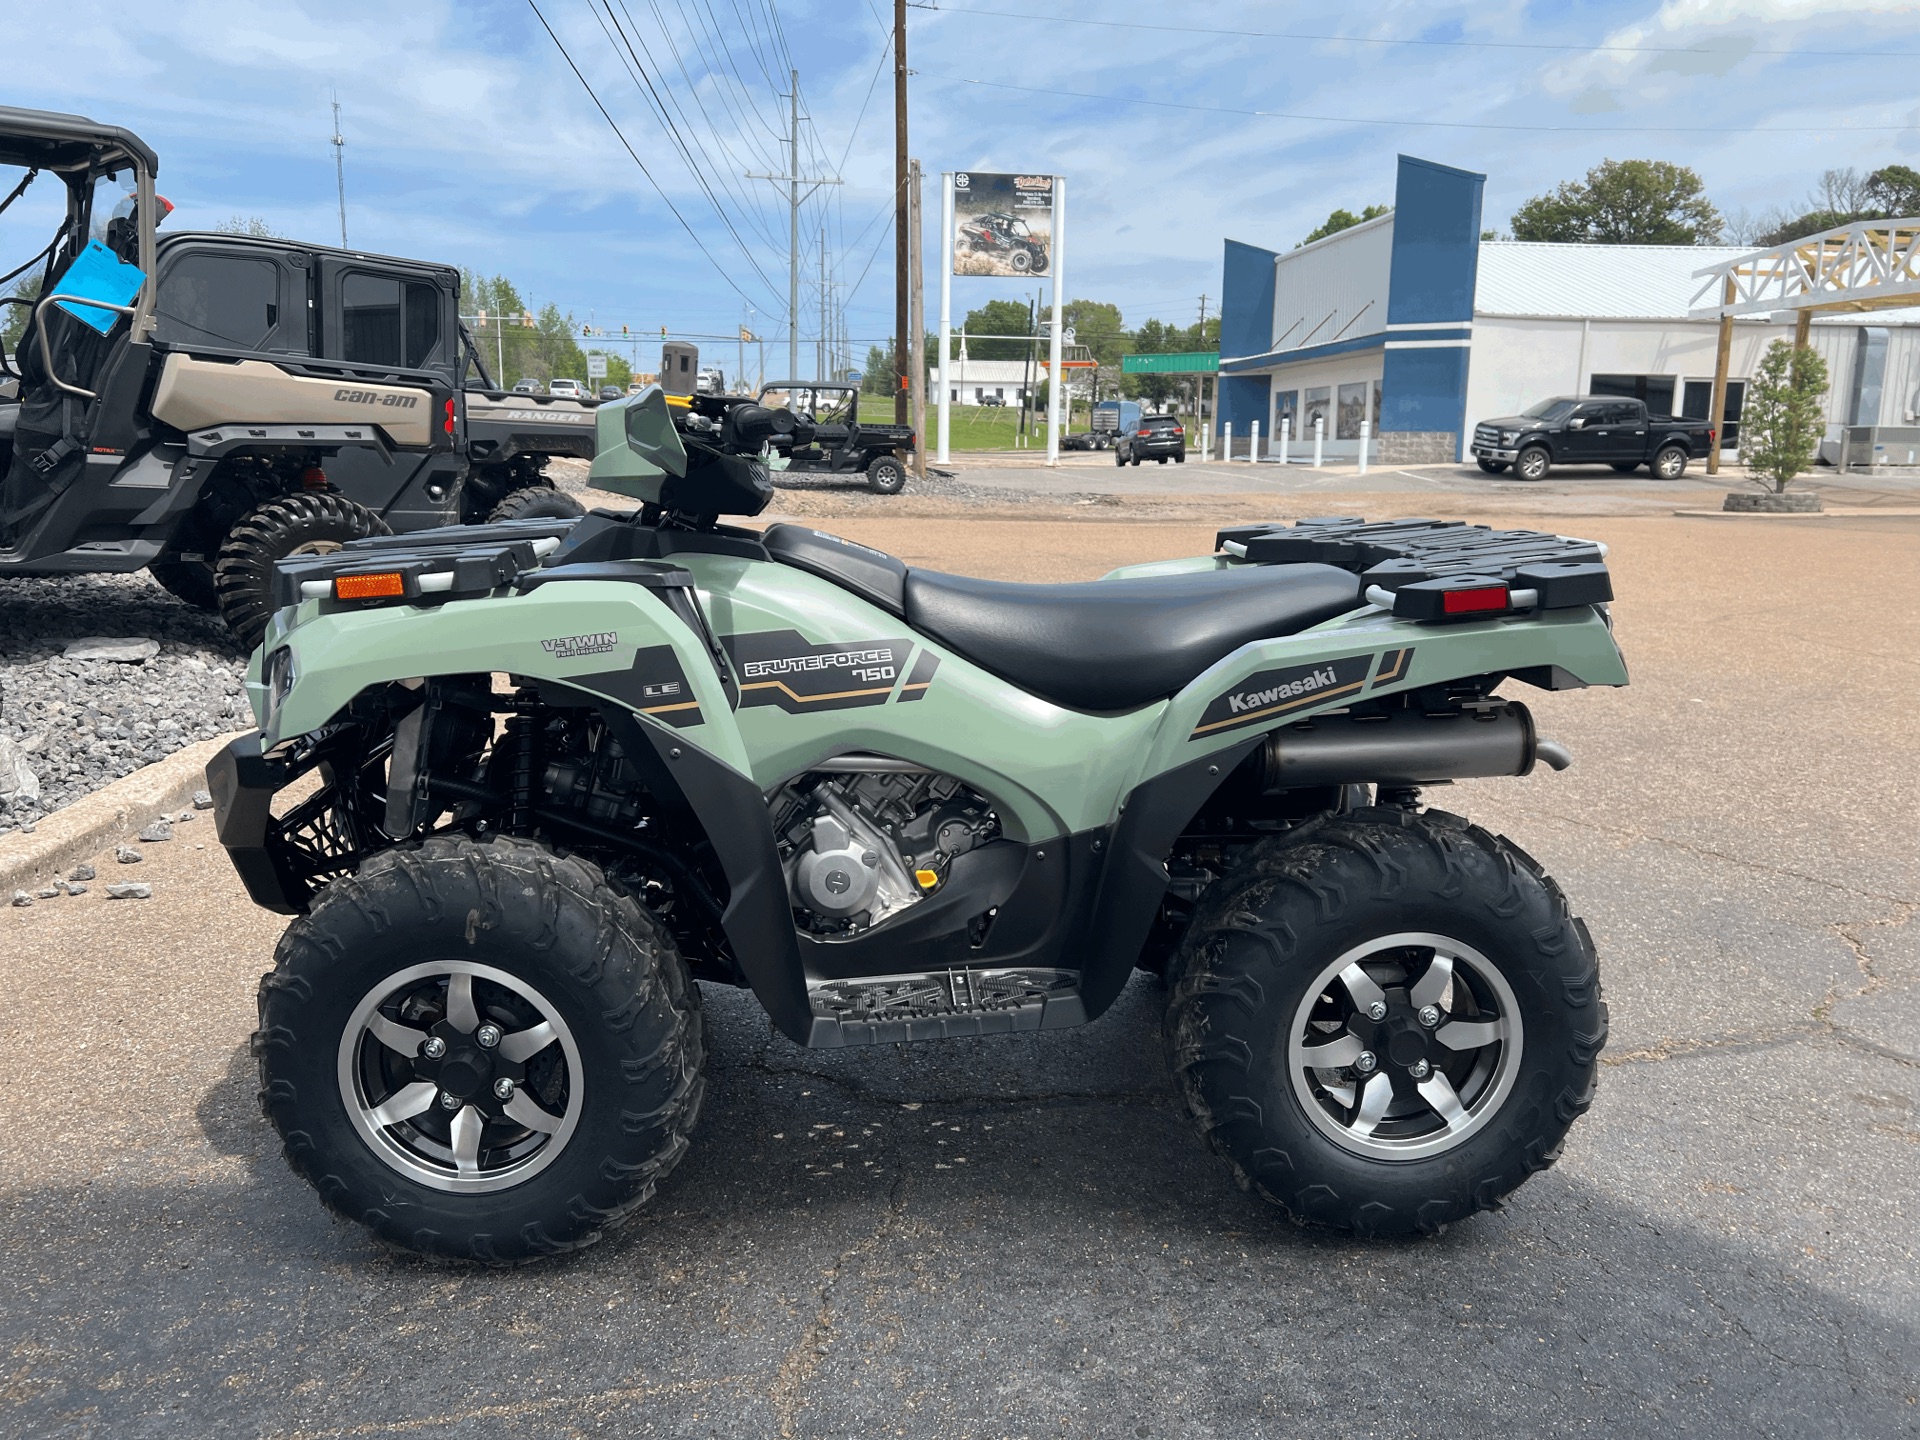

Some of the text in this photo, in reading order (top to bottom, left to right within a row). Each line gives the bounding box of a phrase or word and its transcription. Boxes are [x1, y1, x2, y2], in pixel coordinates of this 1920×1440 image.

[334, 389, 417, 409] can-am
[507, 410, 582, 422] RANGER
[541, 632, 617, 651] V-TWIN
[556, 645, 613, 658] Fuel Injected
[744, 648, 893, 677] BRUTE FORCE
[852, 666, 895, 682] 750
[645, 683, 679, 697] LE
[1229, 666, 1337, 713] Kawasaki
